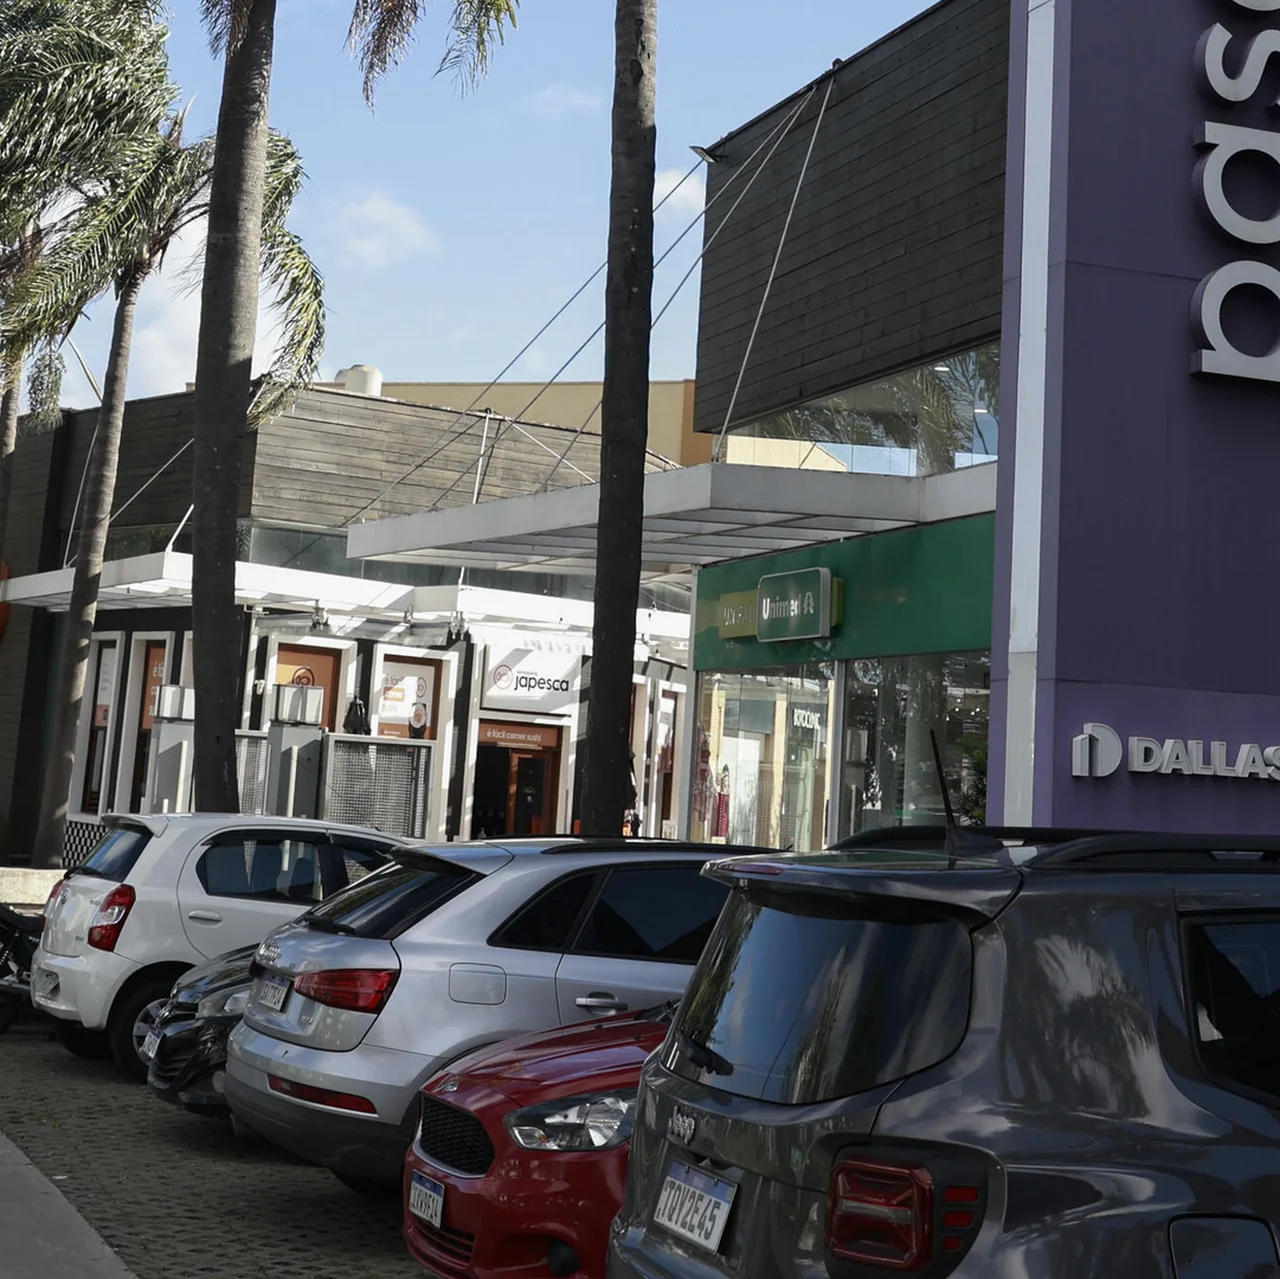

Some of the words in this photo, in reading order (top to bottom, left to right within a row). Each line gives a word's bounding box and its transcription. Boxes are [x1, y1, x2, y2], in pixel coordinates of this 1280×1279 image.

[762, 594, 801, 621] Unimed
[514, 675, 569, 692] japesca
[527, 733, 541, 742] sushi
[669, 1105, 695, 1145] Jeep
[661, 1180, 722, 1241] TQY2E45
